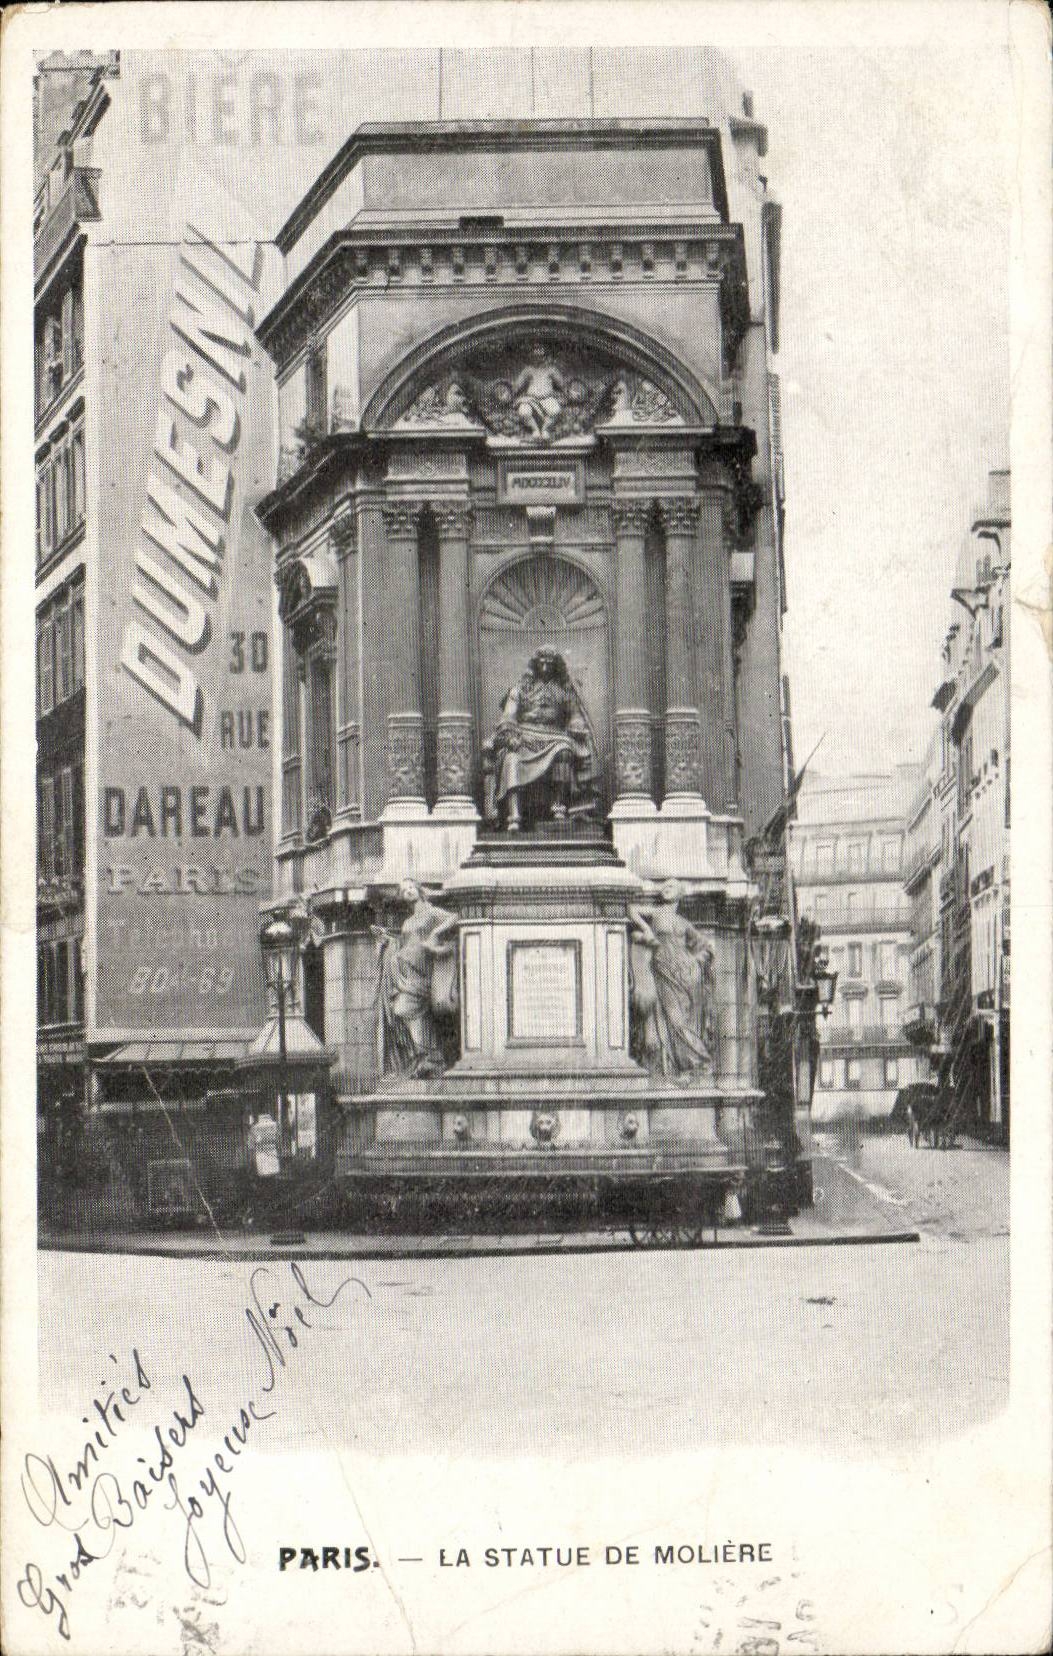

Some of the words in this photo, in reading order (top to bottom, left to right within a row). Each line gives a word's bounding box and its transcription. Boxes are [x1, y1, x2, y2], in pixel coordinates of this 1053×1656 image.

[119, 222, 265, 739] DUMESNIL
[227, 631, 268, 674] 30
[219, 710, 270, 750] RUE
[103, 785, 267, 838] DAREAU
[106, 862, 261, 896] PARIS
